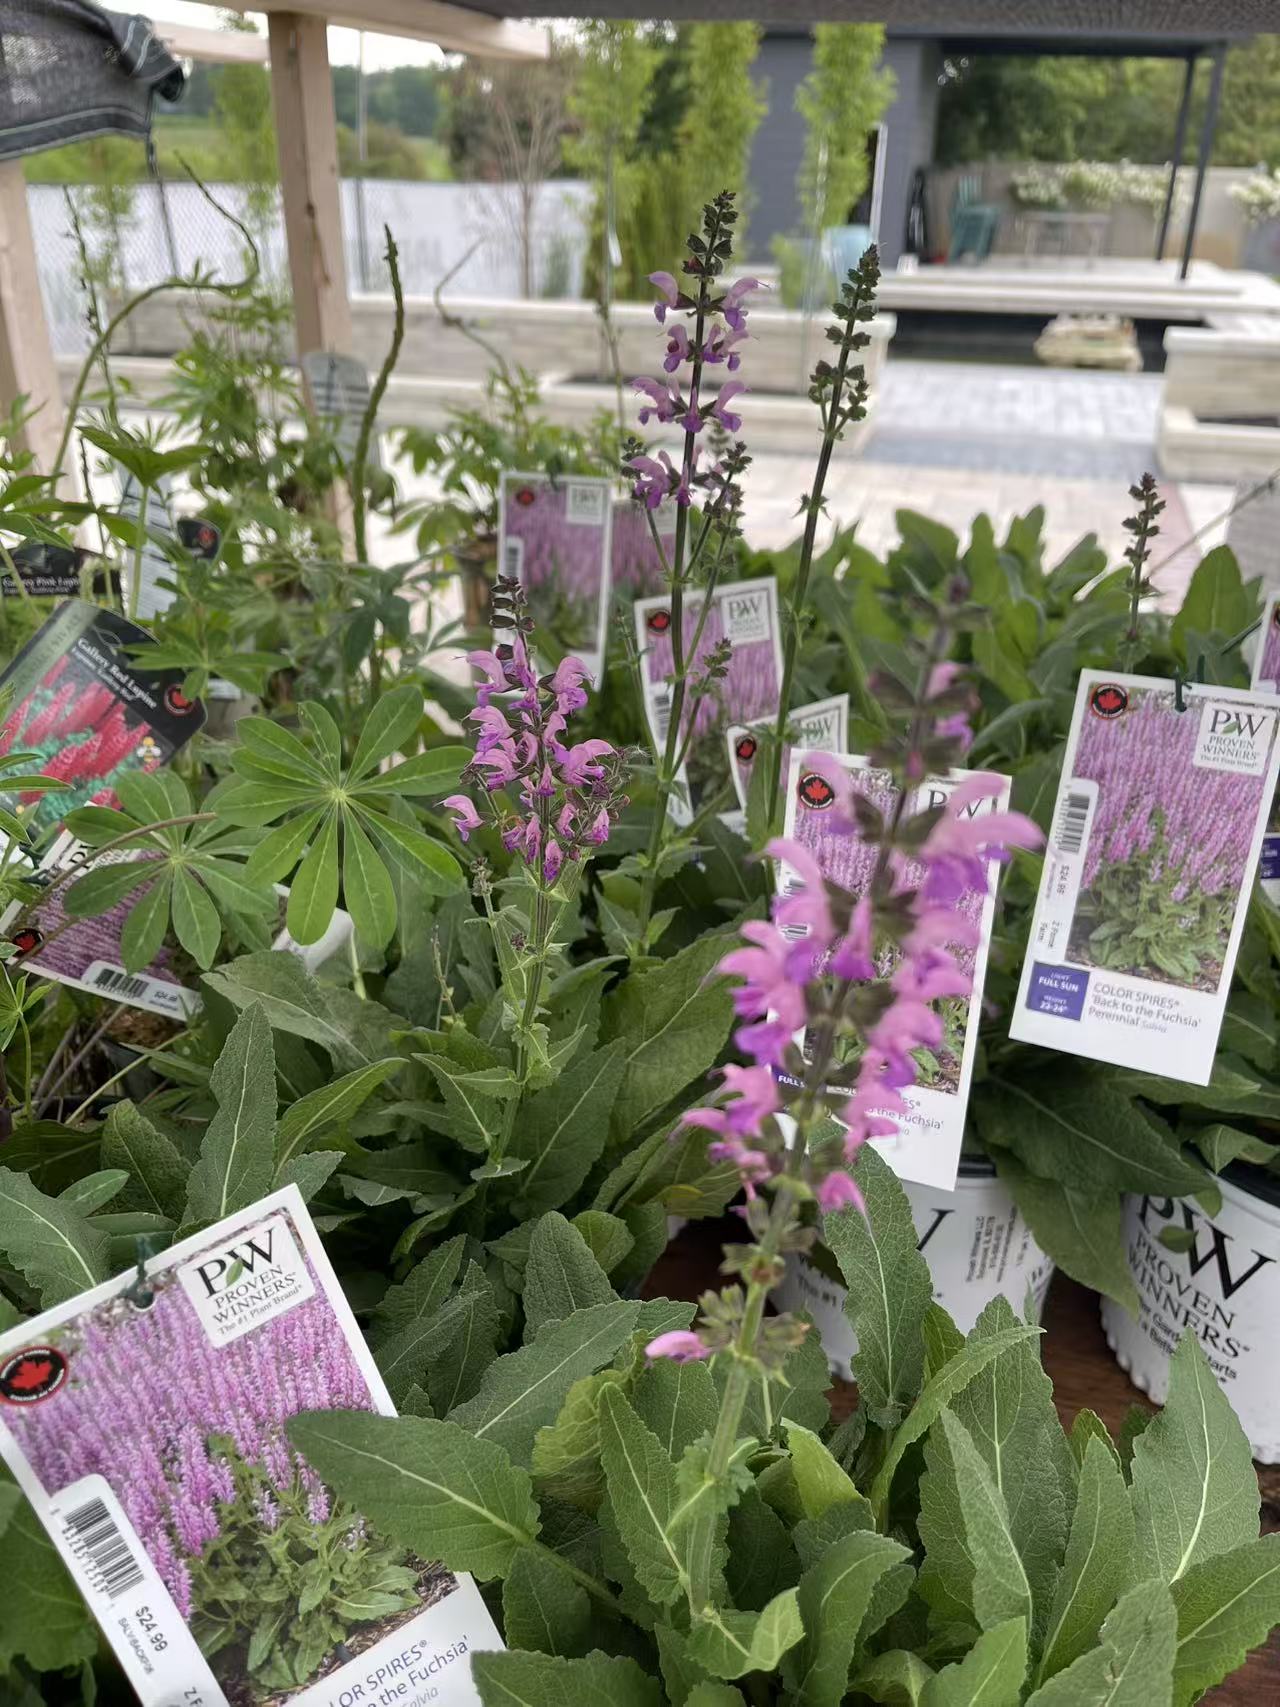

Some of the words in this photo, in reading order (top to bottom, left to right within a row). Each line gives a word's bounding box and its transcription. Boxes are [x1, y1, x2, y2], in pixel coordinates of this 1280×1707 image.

[1208, 708, 1268, 738] PW
[1209, 735, 1255, 750] PROVEN
[1038, 976, 1059, 988] FULL
[1060, 980, 1079, 992] SUN
[1094, 983, 1133, 999] COLOR
[1122, 999, 1133, 1012] to
[1135, 1002, 1154, 1017] the
[778, 1075, 799, 1087] FULL
[193, 1227, 275, 1299] PW
[214, 1264, 284, 1309] PROVEN
[1136, 1231, 1236, 1330] PROVEN
[218, 1323, 236, 1335] The
[250, 1301, 272, 1319] Plant
[135, 1605, 168, 1653] $24.99
[378, 1681, 408, 1706] the
[408, 1634, 469, 1687] Fuchsia'
